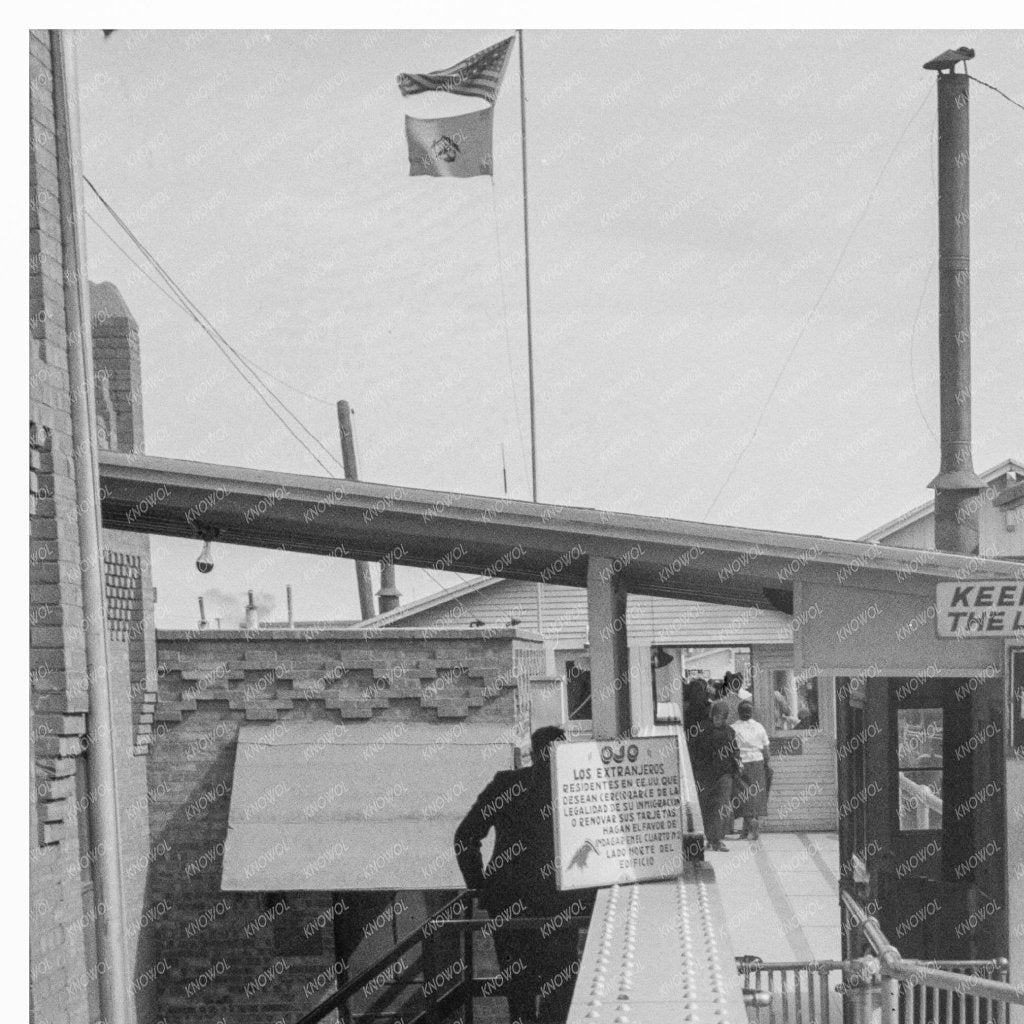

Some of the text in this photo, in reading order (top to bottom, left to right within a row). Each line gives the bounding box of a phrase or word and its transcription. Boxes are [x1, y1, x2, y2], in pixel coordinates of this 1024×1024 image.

[948, 611, 1005, 632] THE
[600, 744, 639, 764] OJO
[573, 763, 665, 780] LOS EXTRANJEROS
[563, 781, 619, 793] RESIDENTES
[621, 779, 633, 788] EN
[661, 776, 678, 786] QUE
[562, 794, 597, 805] DESEAN
[656, 788, 668, 797] DE
[669, 787, 679, 796] LA
[563, 804, 608, 817] LEGALIDAD
[610, 803, 620, 812] DE
[623, 802, 634, 811] SU
[579, 815, 616, 827] RENOVAR
[619, 813, 634, 823] SUS
[637, 808, 676, 820] TARJETAS
[603, 820, 678, 835] HAGAN EL FAVOR DE
[606, 844, 674, 858] LADO NORTE DEL
[619, 857, 654, 868] EDIFICIO
